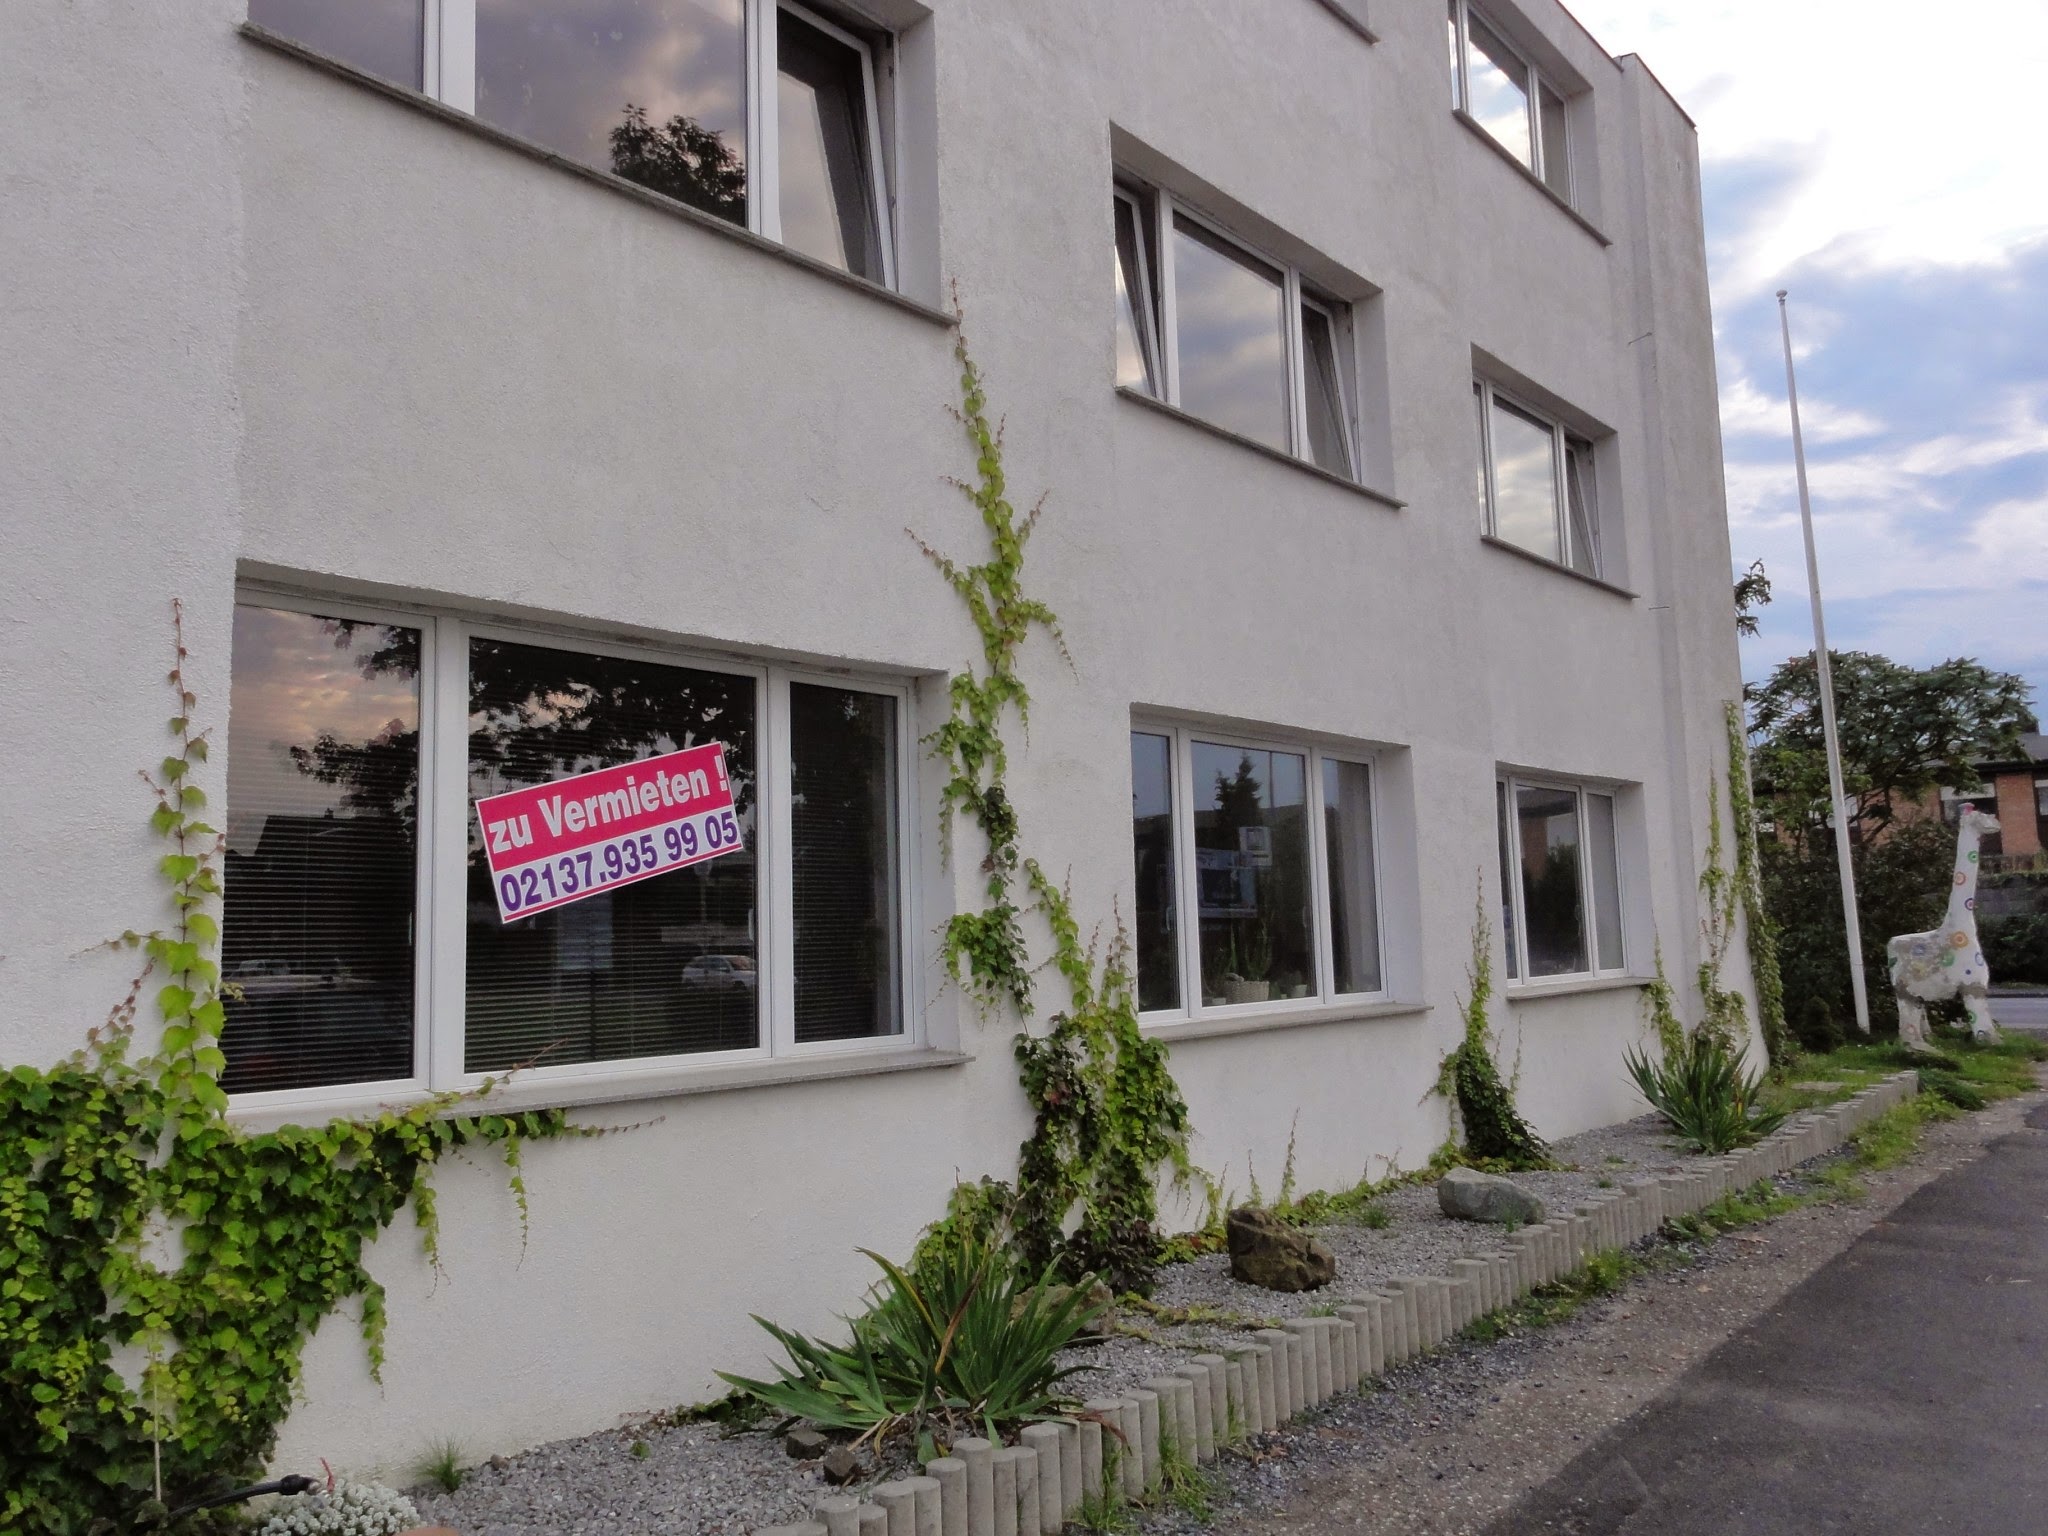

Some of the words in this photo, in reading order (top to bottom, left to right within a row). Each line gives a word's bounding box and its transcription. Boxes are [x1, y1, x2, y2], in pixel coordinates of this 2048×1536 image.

[488, 814, 533, 854] zu
[538, 768, 710, 837] Vermieten
[714, 755, 728, 791] !
[500, 834, 658, 912] 02137.935
[664, 822, 698, 861] 99
[705, 811, 738, 849] 05
